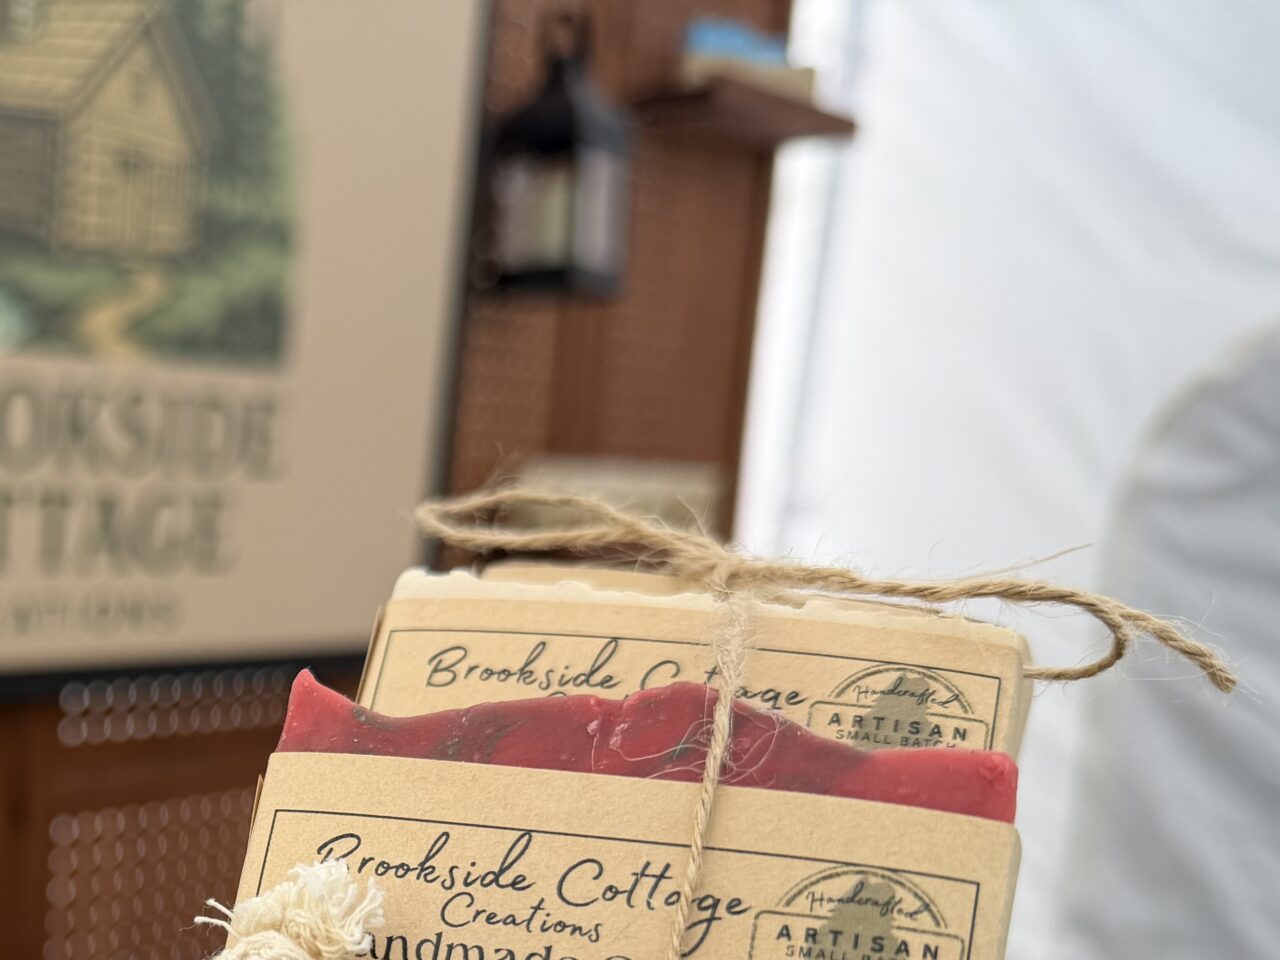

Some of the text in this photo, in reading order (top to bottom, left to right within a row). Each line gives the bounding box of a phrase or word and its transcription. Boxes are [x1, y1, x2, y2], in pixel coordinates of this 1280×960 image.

[426, 637, 807, 710] Brookside Ctage
[853, 676, 960, 709] Handcrafted
[828, 713, 967, 741] ARTISAN
[835, 730, 891, 745] SMALL
[441, 892, 602, 944] Creations
[557, 858, 751, 958] Cottage
[806, 881, 929, 921] Handcrafted
[776, 924, 939, 960] ARTISAN
